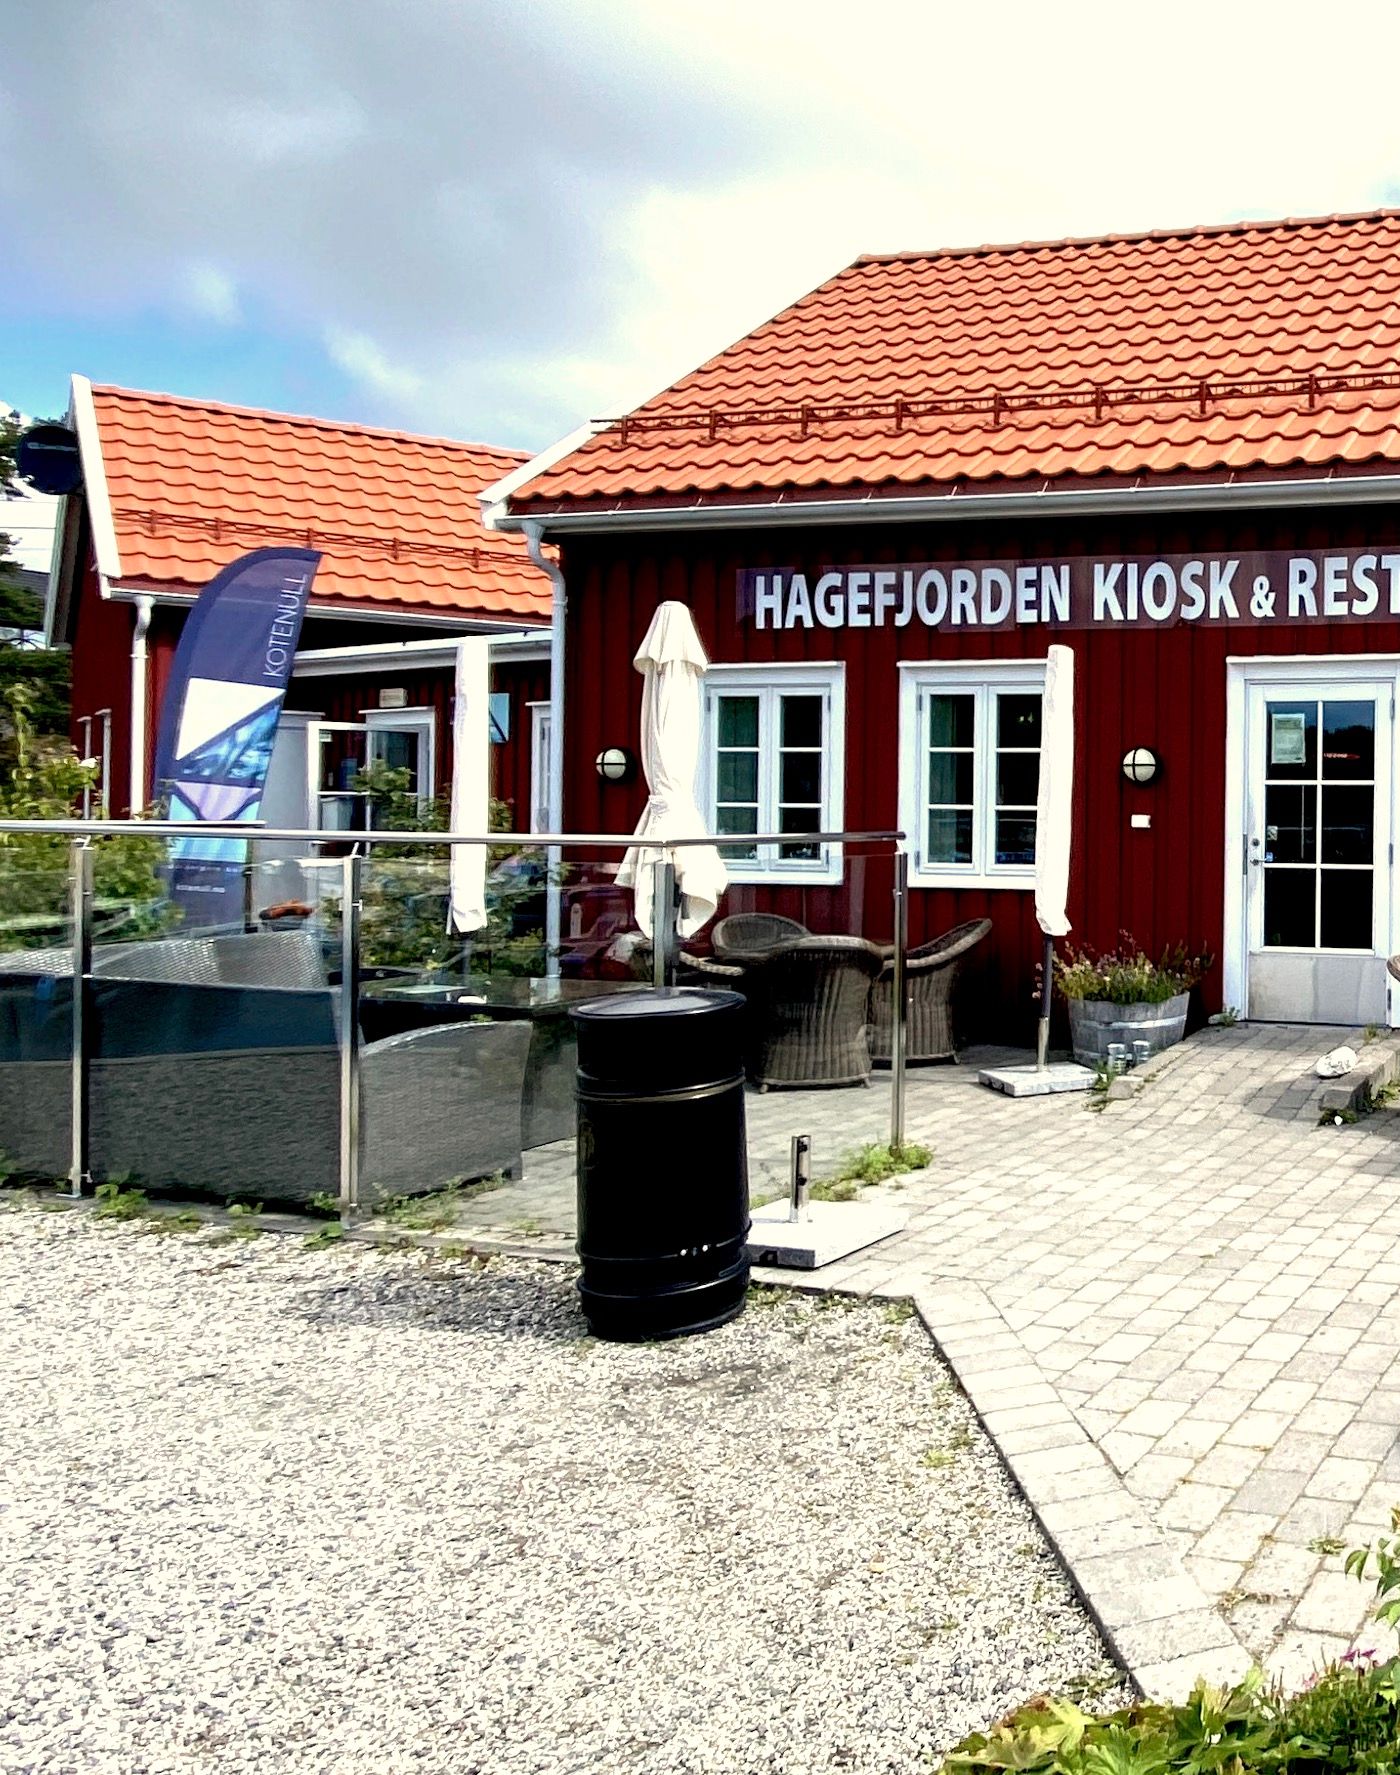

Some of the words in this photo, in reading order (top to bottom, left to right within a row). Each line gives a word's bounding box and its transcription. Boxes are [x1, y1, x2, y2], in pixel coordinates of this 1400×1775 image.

[262, 573, 308, 678] KOTENULL
[754, 563, 1070, 631] HAGEFJORDEN
[1092, 559, 1241, 623] KIOSK
[1248, 574, 1277, 619] &
